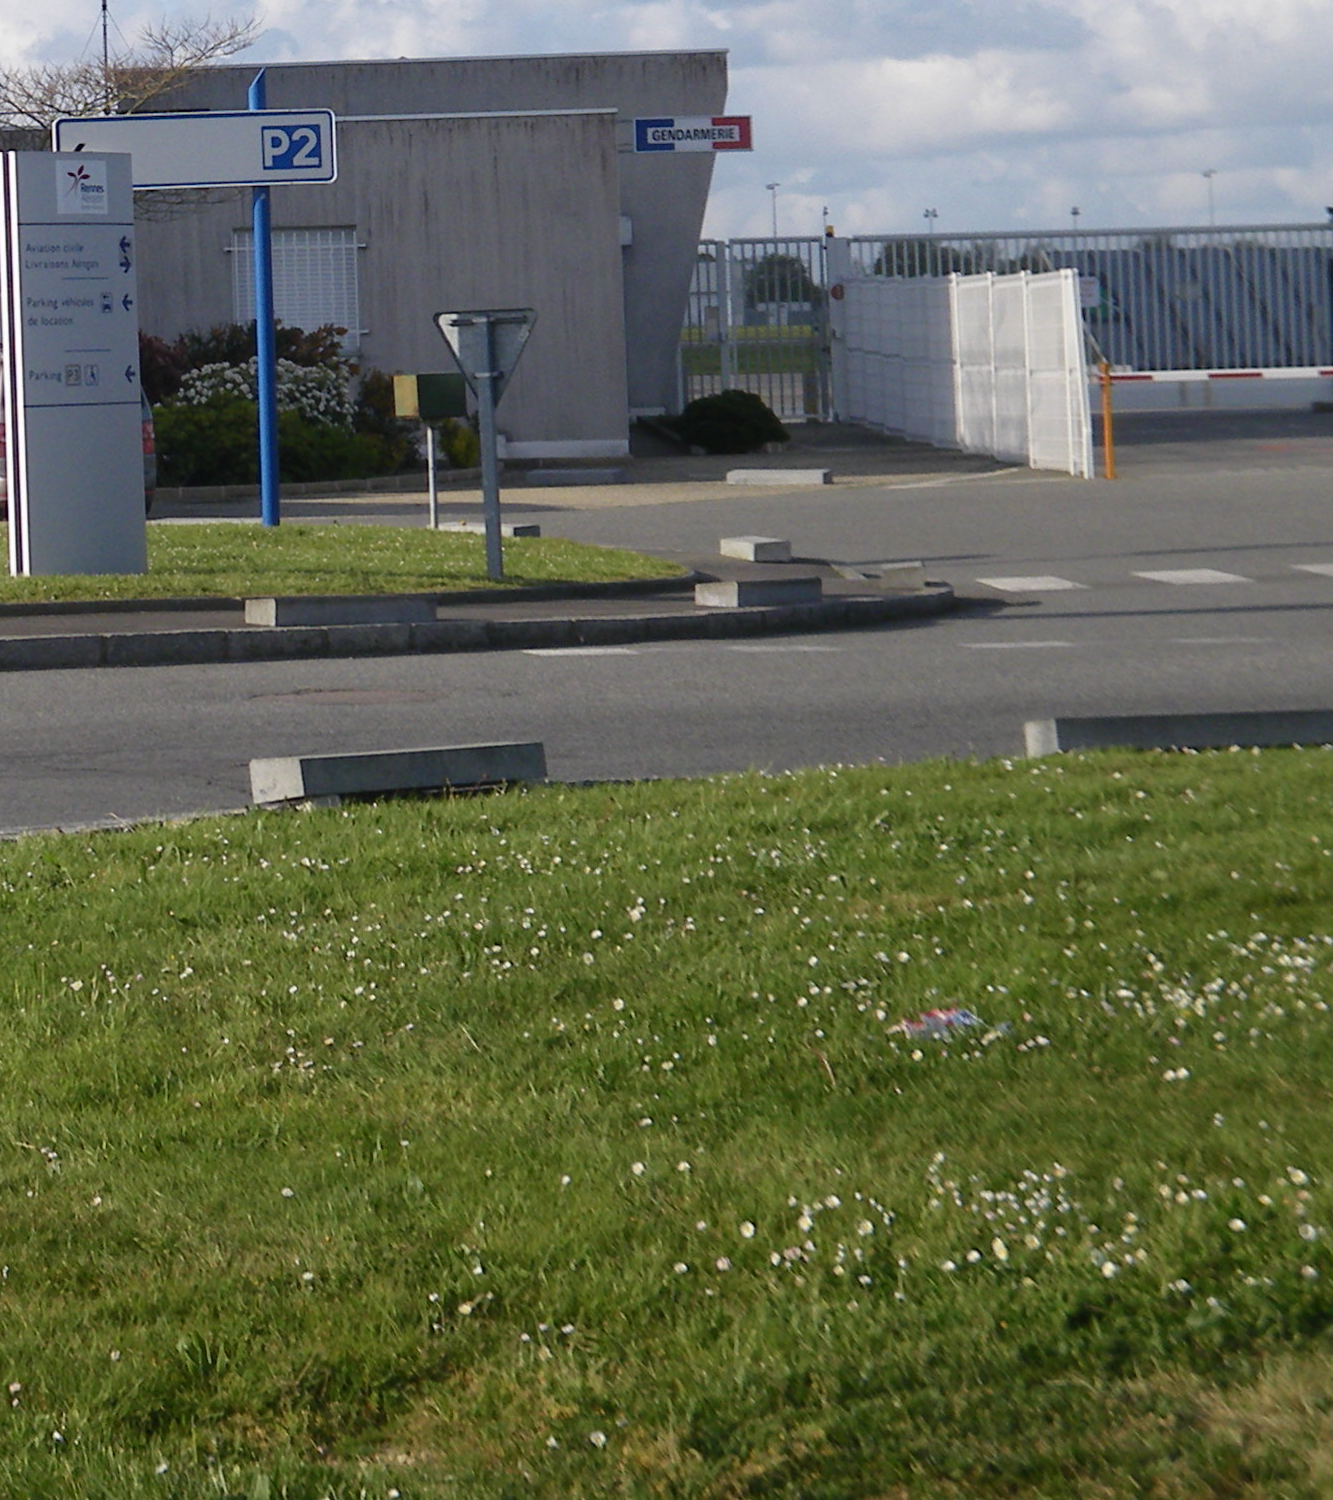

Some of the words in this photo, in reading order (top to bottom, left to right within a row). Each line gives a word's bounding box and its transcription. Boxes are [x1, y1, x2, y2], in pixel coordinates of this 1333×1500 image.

[652, 127, 735, 141] GENDARMERIE
[263, 127, 320, 168] P2
[27, 297, 58, 310] Parking
[27, 316, 37, 326] de
[41, 316, 74, 326] location
[28, 369, 62, 383] Parking
